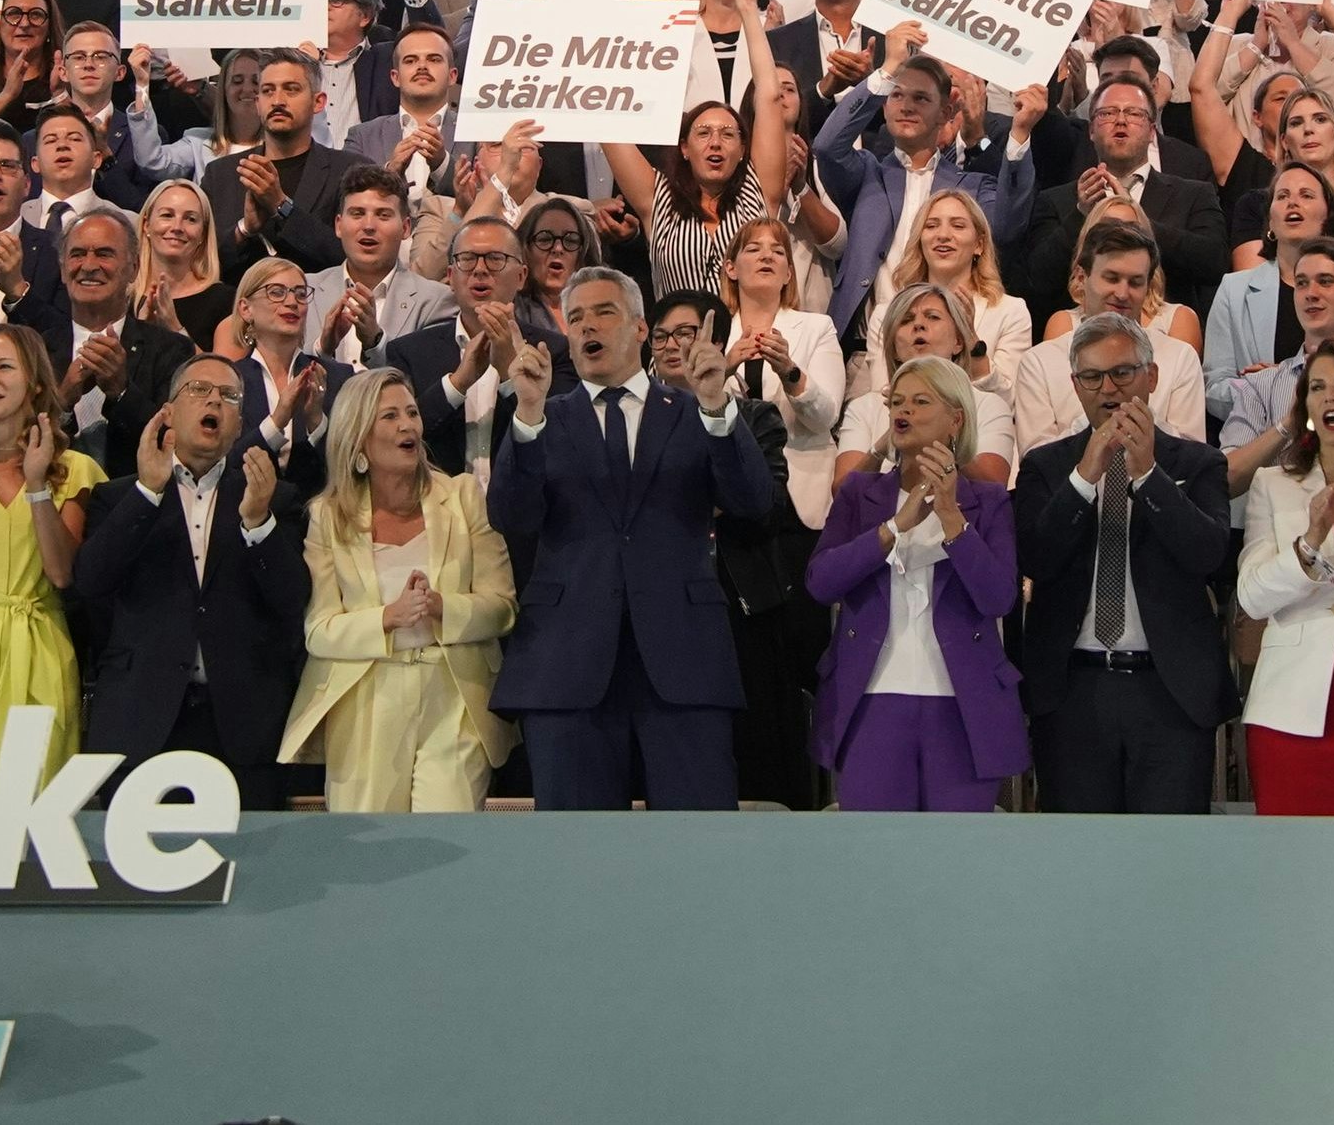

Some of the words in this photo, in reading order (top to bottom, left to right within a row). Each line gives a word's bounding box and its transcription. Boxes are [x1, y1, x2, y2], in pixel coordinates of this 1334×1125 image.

[482, 34, 553, 68] Die
[561, 35, 679, 71] Mitte
[473, 74, 644, 112] stärken.
